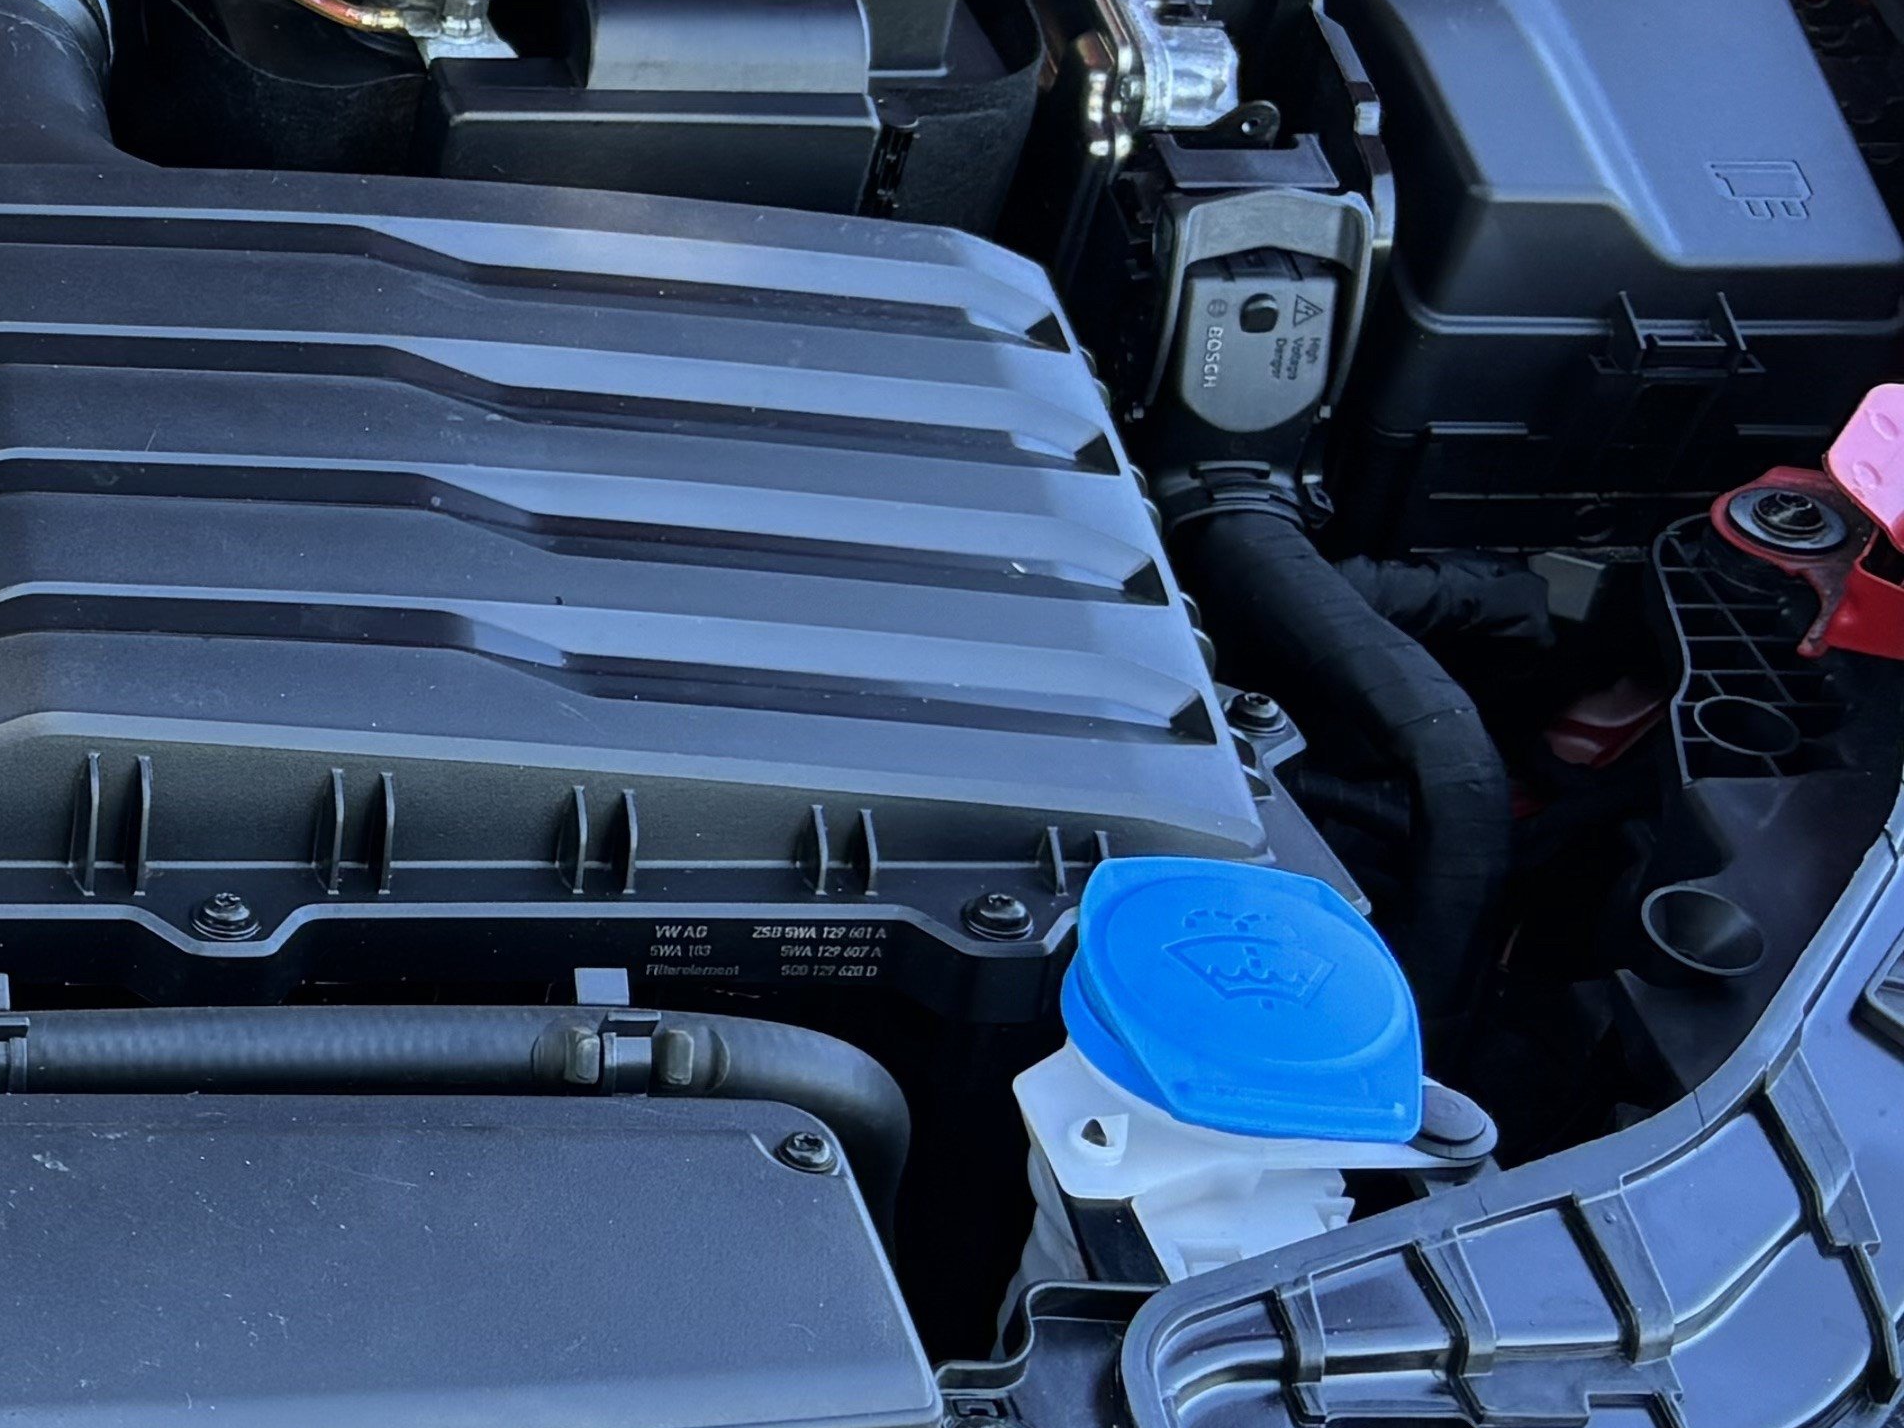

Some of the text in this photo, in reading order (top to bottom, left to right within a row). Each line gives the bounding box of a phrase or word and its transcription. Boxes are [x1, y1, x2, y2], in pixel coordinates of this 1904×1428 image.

[1304, 336, 1323, 364] High
[1203, 326, 1225, 389] BOSCH
[655, 925, 708, 939] VW AG
[822, 926, 846, 939] 129
[875, 927, 887, 939] A
[817, 945, 840, 957] 129
[870, 946, 882, 958] A
